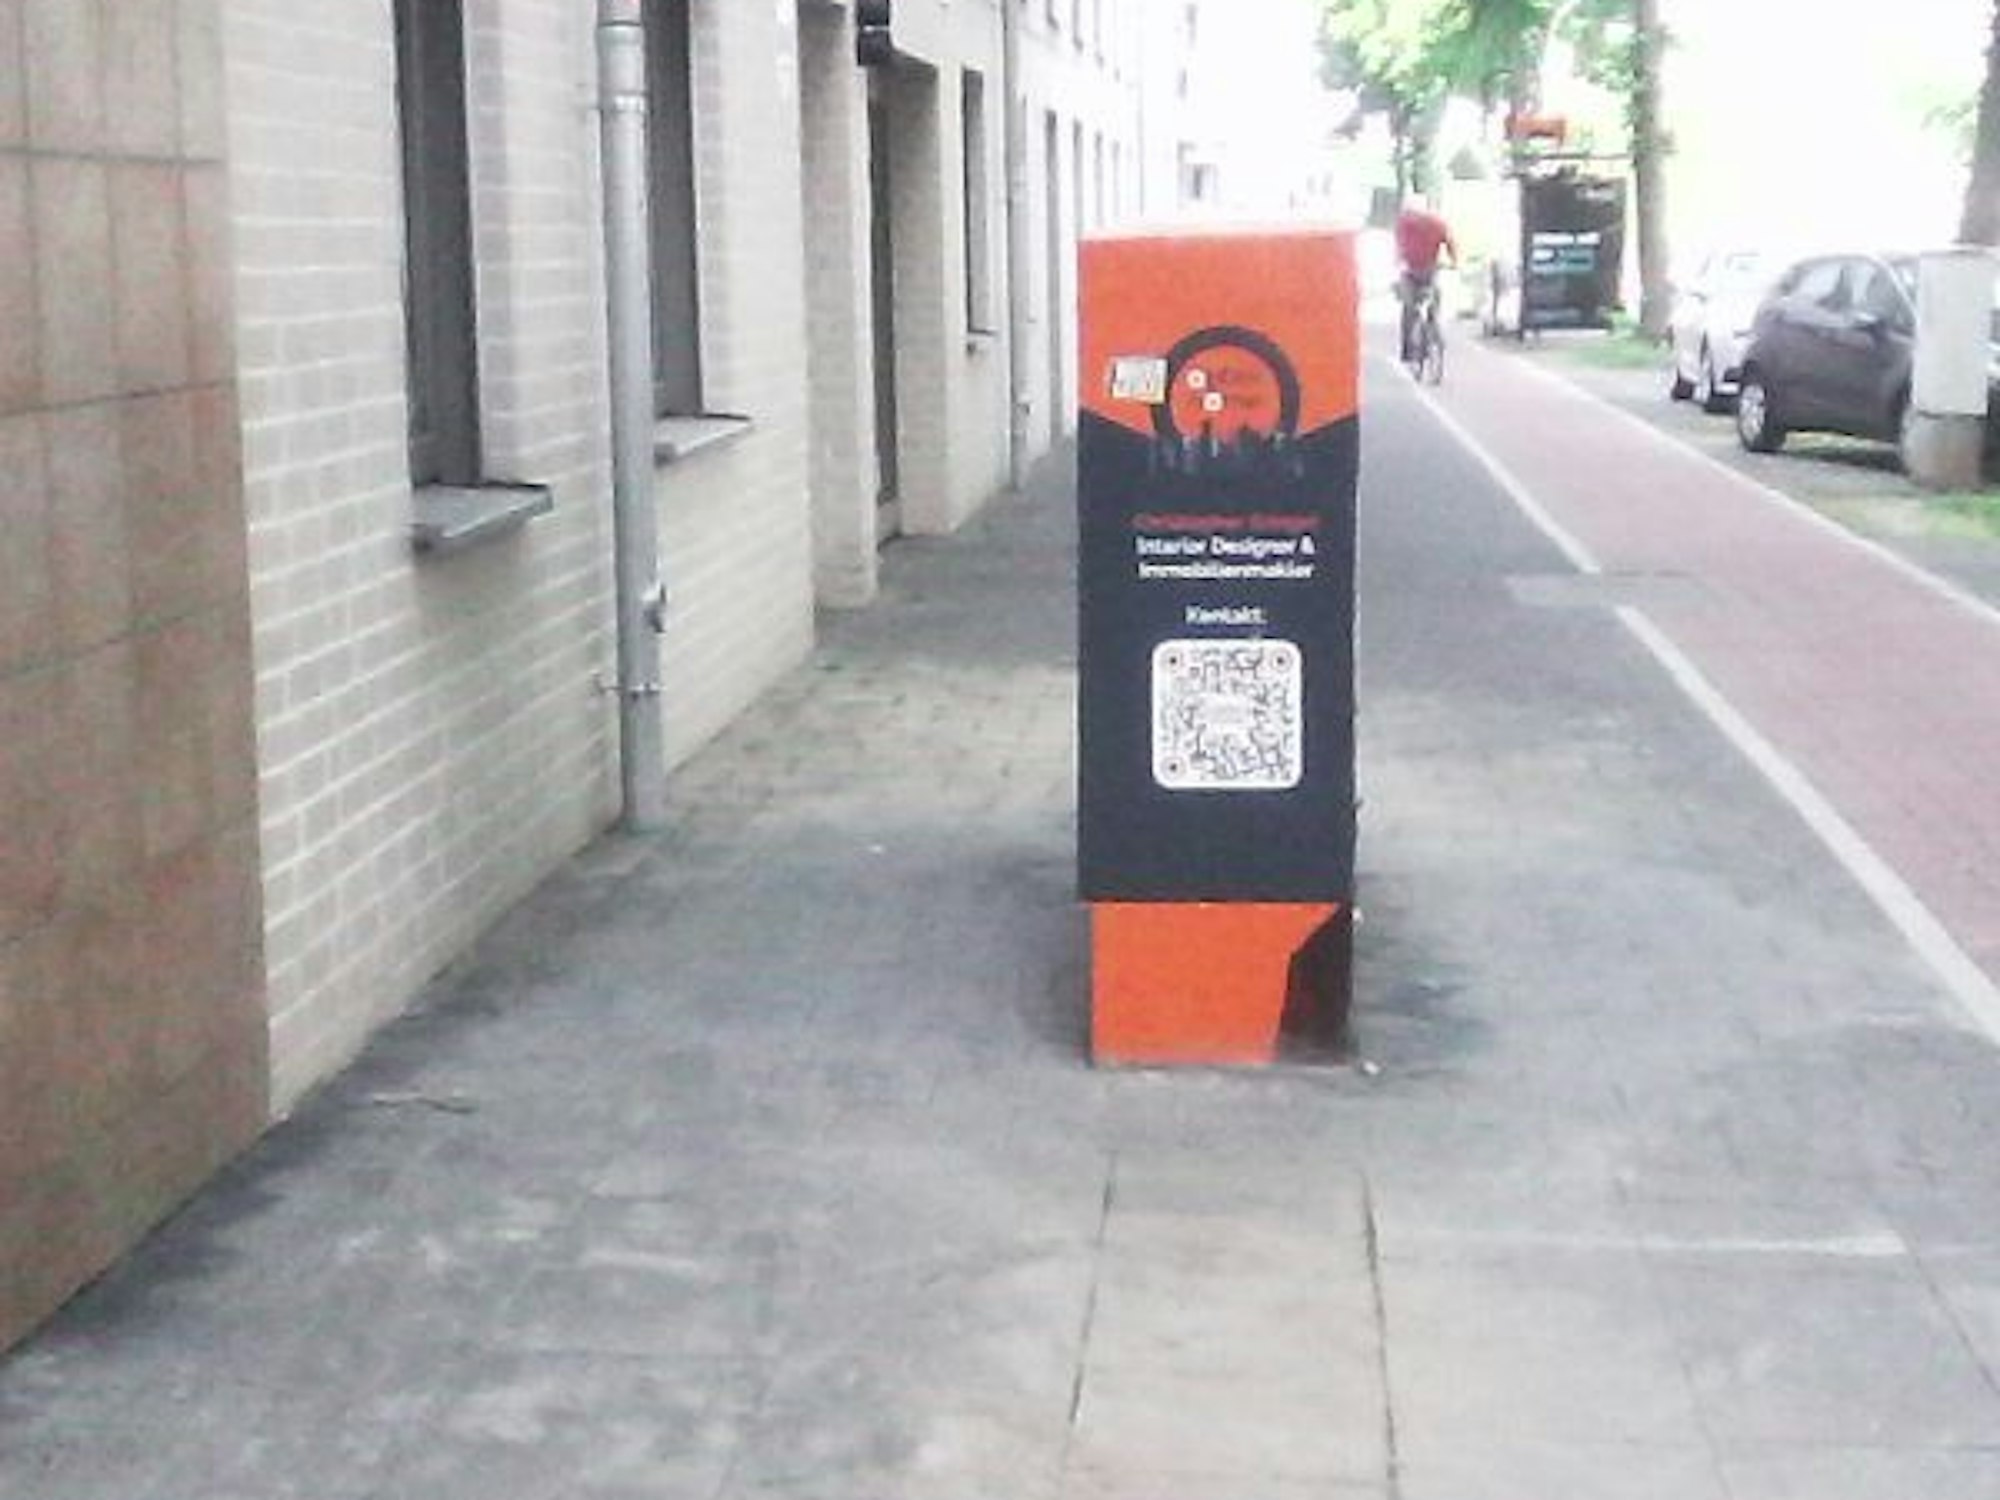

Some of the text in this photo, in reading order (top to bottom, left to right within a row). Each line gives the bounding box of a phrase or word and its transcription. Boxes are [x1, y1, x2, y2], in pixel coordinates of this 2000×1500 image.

[1136, 535, 1315, 558] Interior Designer &
